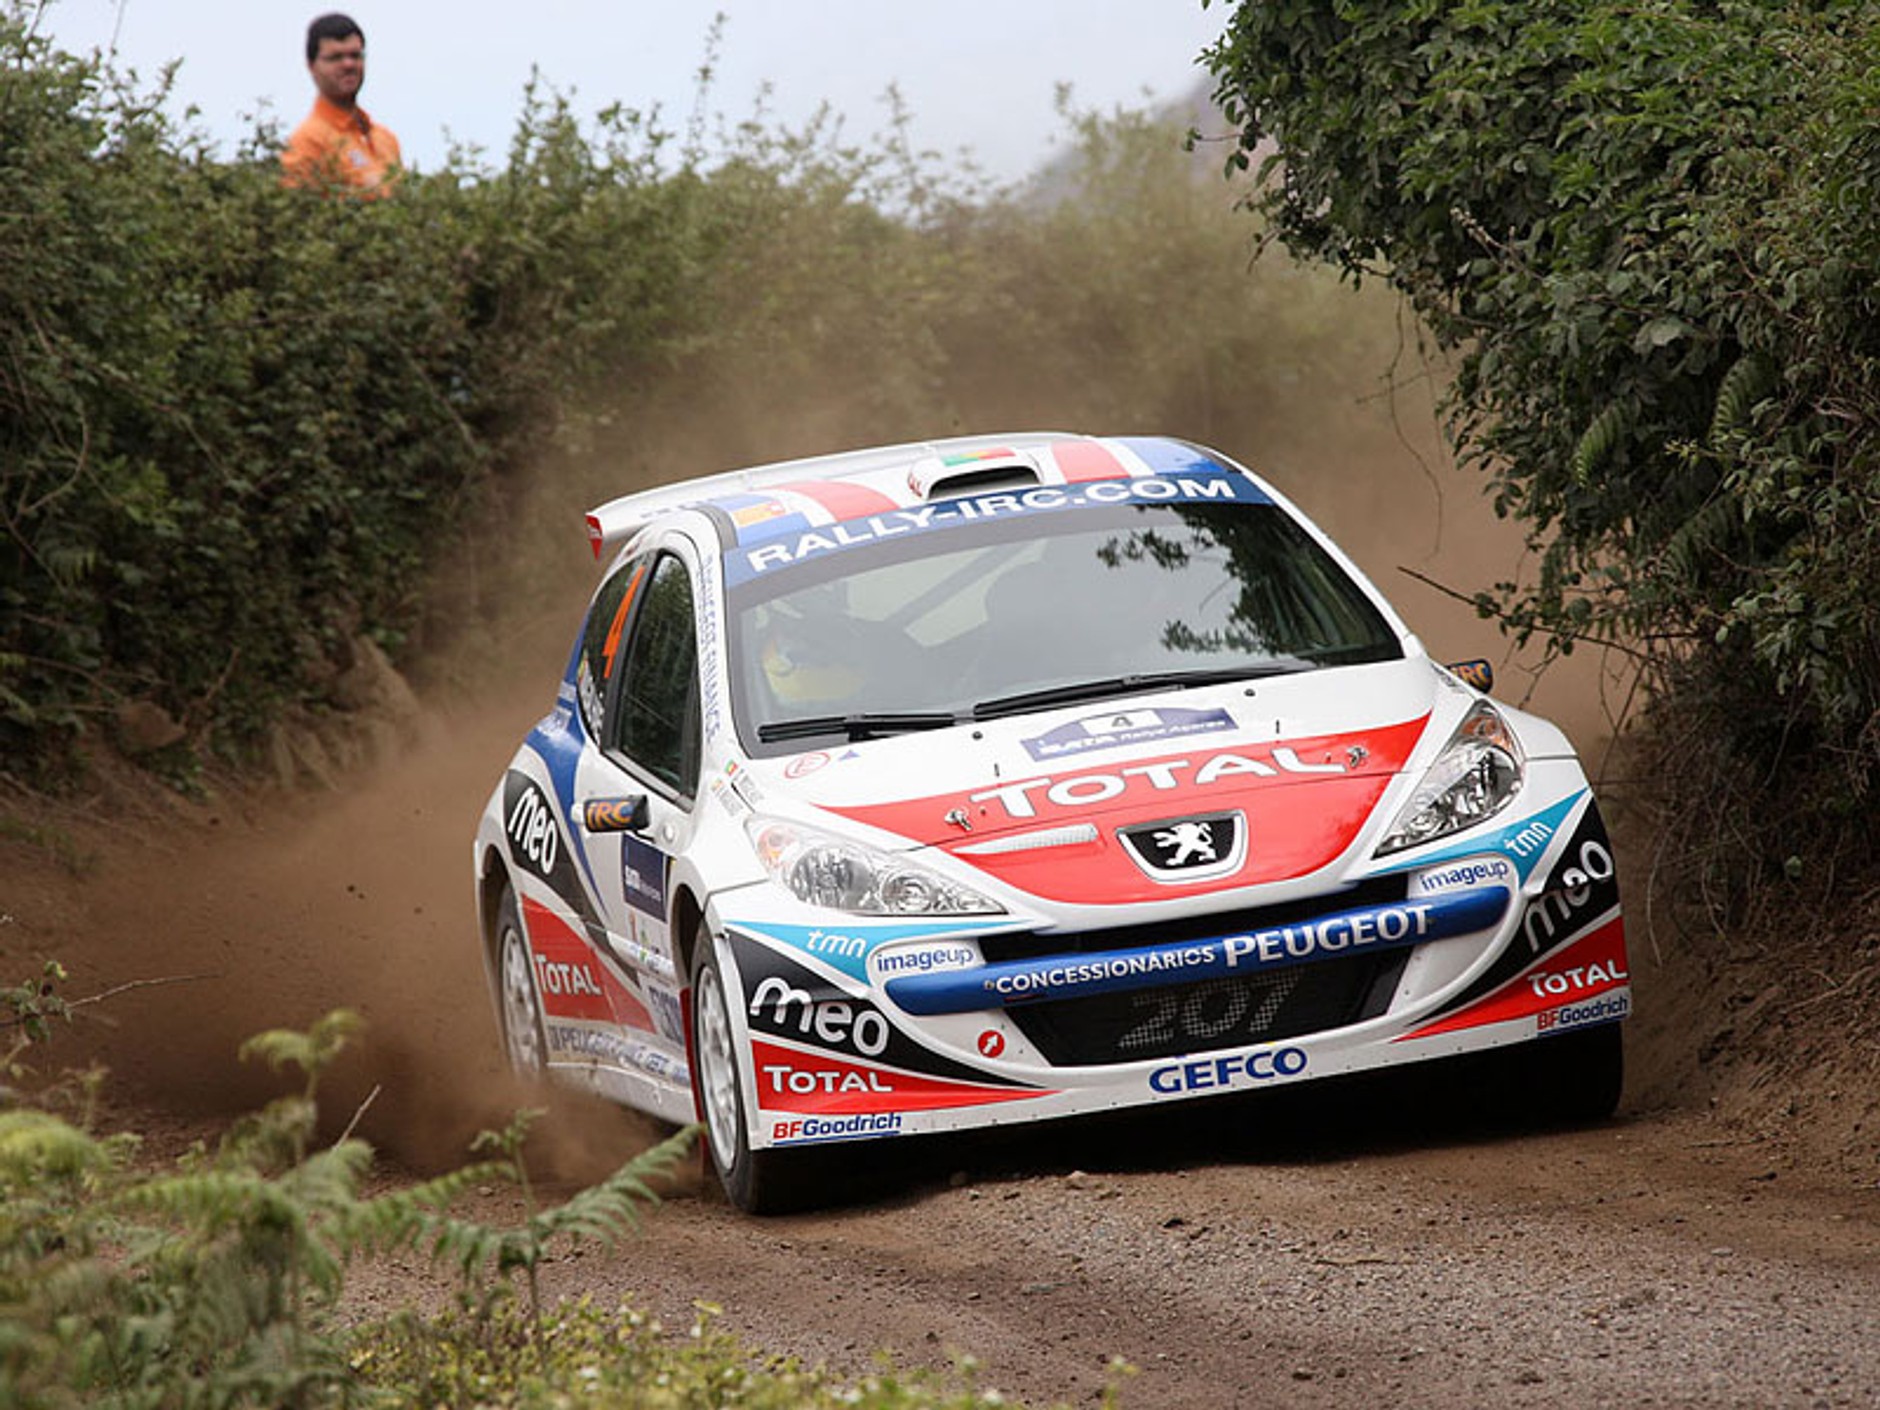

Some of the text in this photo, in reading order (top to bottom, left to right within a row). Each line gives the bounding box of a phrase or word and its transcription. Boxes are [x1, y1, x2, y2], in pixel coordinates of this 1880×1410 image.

[747, 478, 1236, 573] RALLY-IRC.COM
[602, 565, 646, 678] 4
[1111, 715, 1134, 727] 4
[970, 747, 1347, 818] TOTAL
[508, 786, 558, 875] meo
[1505, 821, 1554, 858] tmn
[1420, 860, 1509, 891] imageup
[1524, 840, 1614, 953] meo
[806, 929, 866, 959] tmn
[1223, 904, 1434, 968] PEUGEOT
[534, 953, 603, 996] TOTAL
[876, 947, 974, 972] imageup
[1527, 958, 1629, 999] TOTAL
[750, 976, 890, 1056] meo
[1117, 968, 1302, 1048] 207
[1536, 997, 1628, 1031] BFGoodrich
[762, 1065, 894, 1094] TOTAL
[1148, 1047, 1308, 1094] GEFCO
[772, 1112, 902, 1140] BFGoodrich
